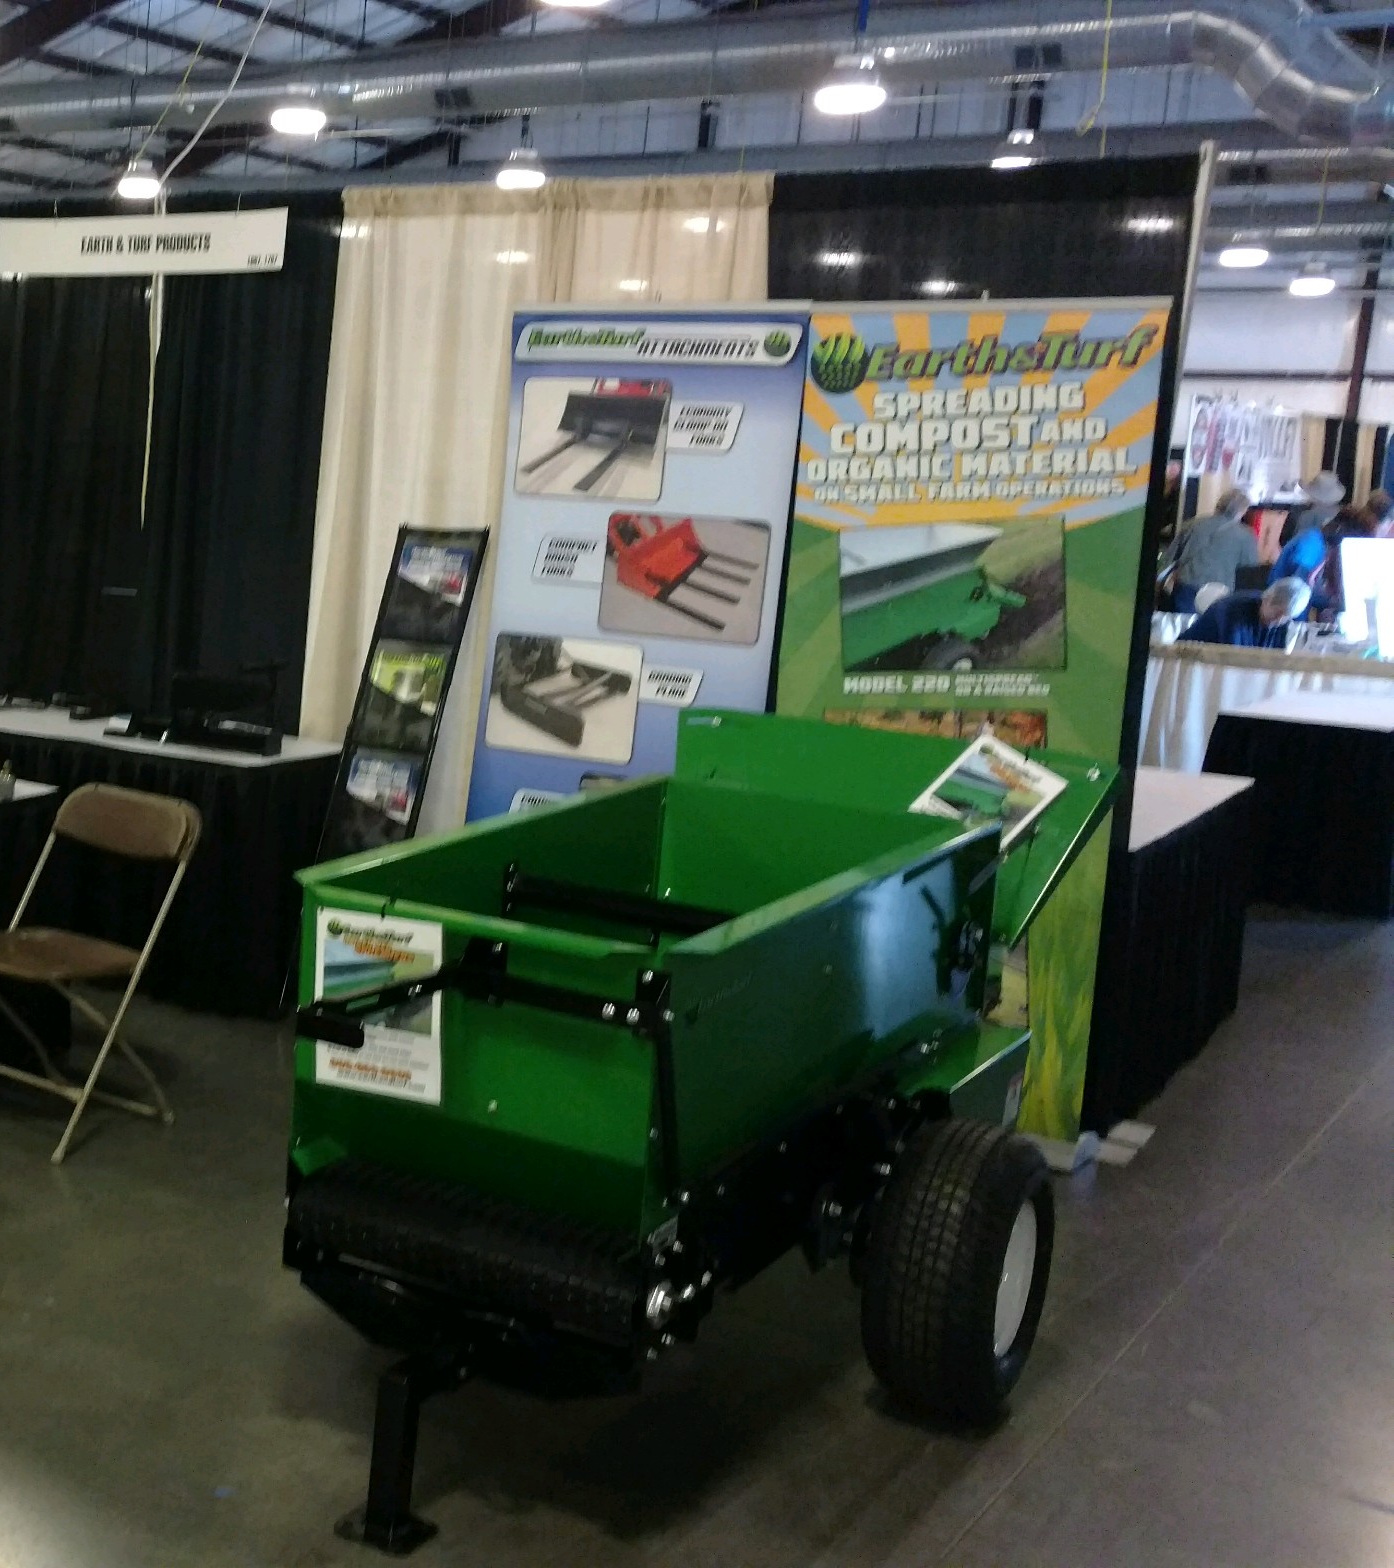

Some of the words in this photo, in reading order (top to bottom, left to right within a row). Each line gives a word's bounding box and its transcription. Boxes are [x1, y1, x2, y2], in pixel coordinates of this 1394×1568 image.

[80, 235, 113, 255] EARTH
[116, 236, 124, 254] &
[128, 235, 153, 254] TURF
[155, 232, 211, 253] PRODUCTS
[873, 382, 1086, 420] SPREADING
[830, 415, 1040, 455] COMPOST
[1041, 417, 1106, 444] AND
[807, 452, 953, 483] ORGANIC
[961, 447, 1137, 479] MATERIAL
[813, 486, 840, 503] ON
[844, 484, 922, 503] SMALL
[928, 481, 991, 500] FARM
[995, 477, 1126, 498] OPERATIONS
[843, 674, 908, 695] MODEL
